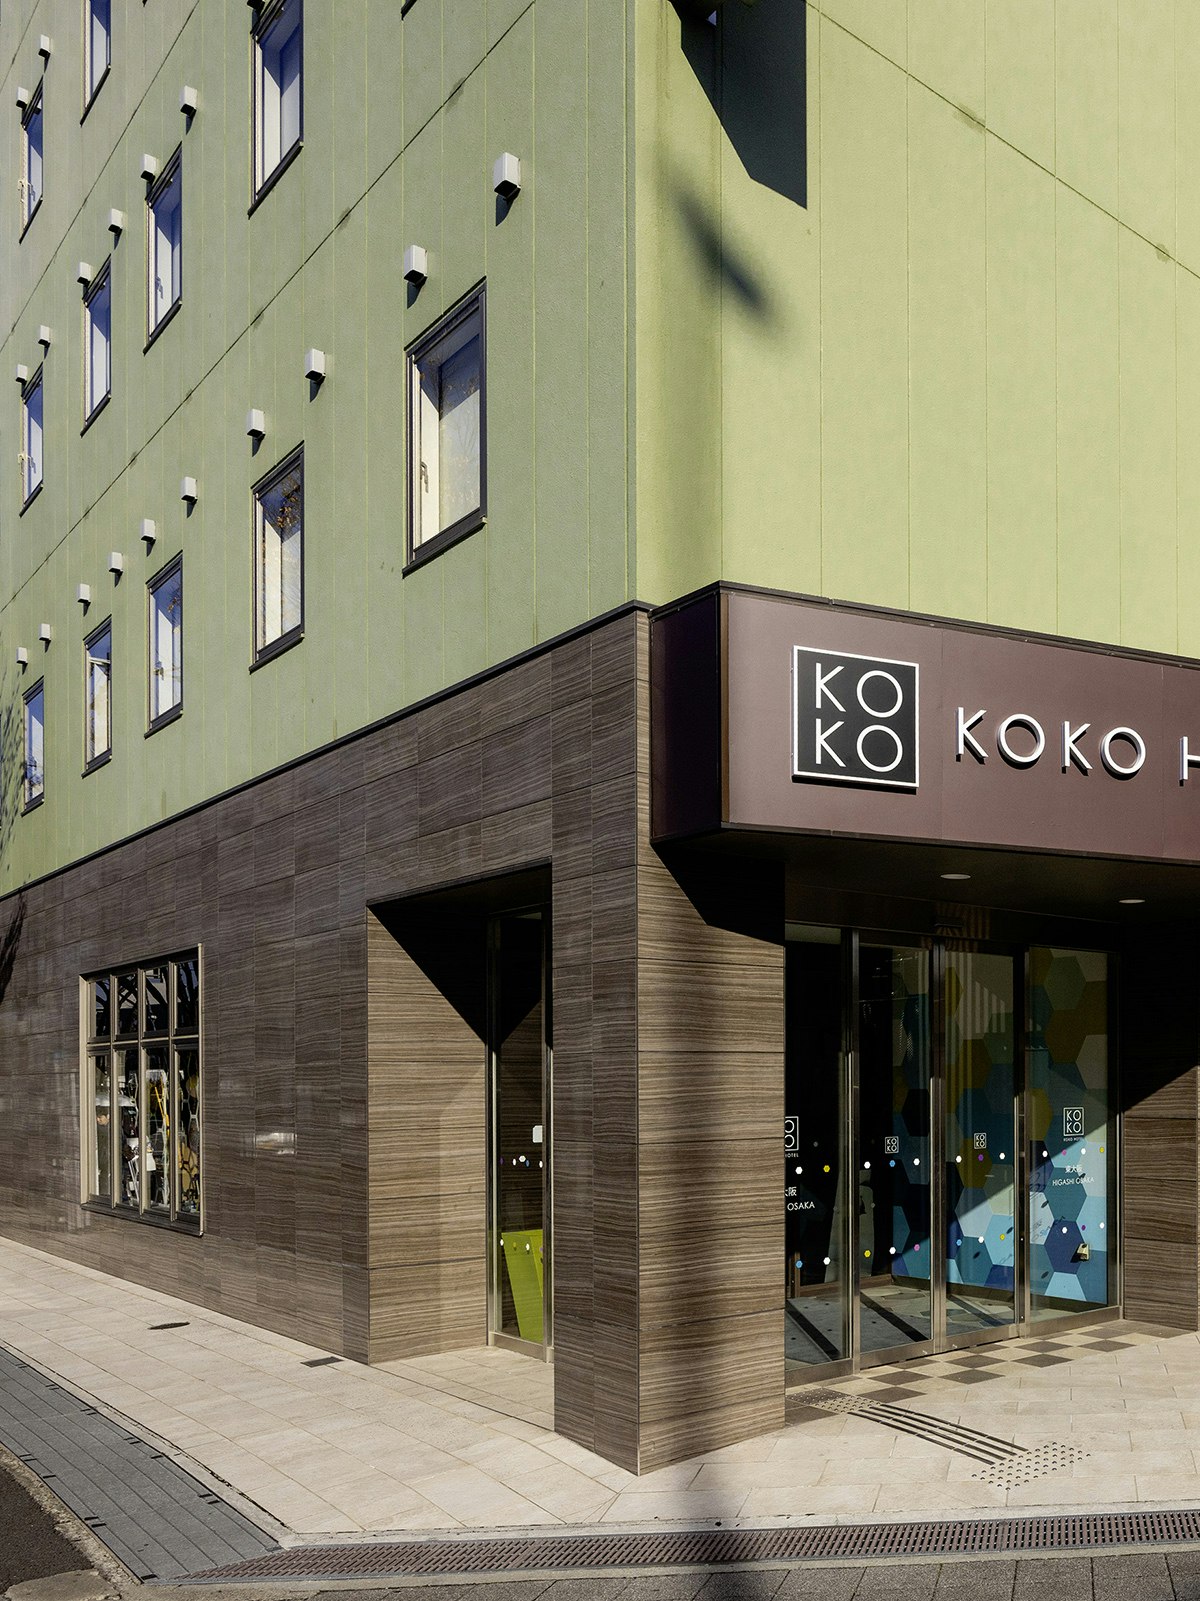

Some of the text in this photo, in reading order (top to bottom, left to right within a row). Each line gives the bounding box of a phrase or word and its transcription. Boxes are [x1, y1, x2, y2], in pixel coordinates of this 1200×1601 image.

[815, 662, 903, 718] KO
[815, 718, 903, 773] KO
[955, 707, 1147, 775] KOKO
[1066, 1110, 1082, 1121] KO
[784, 1120, 795, 1133] O
[1066, 1122, 1082, 1133] KO
[784, 1134, 795, 1148] O
[976, 1133, 985, 1141] KO
[976, 1140, 985, 1148] KO
[1052, 1176, 1095, 1186] HIGASHI OSAKA
[787, 1201, 816, 1211] OSAKA
